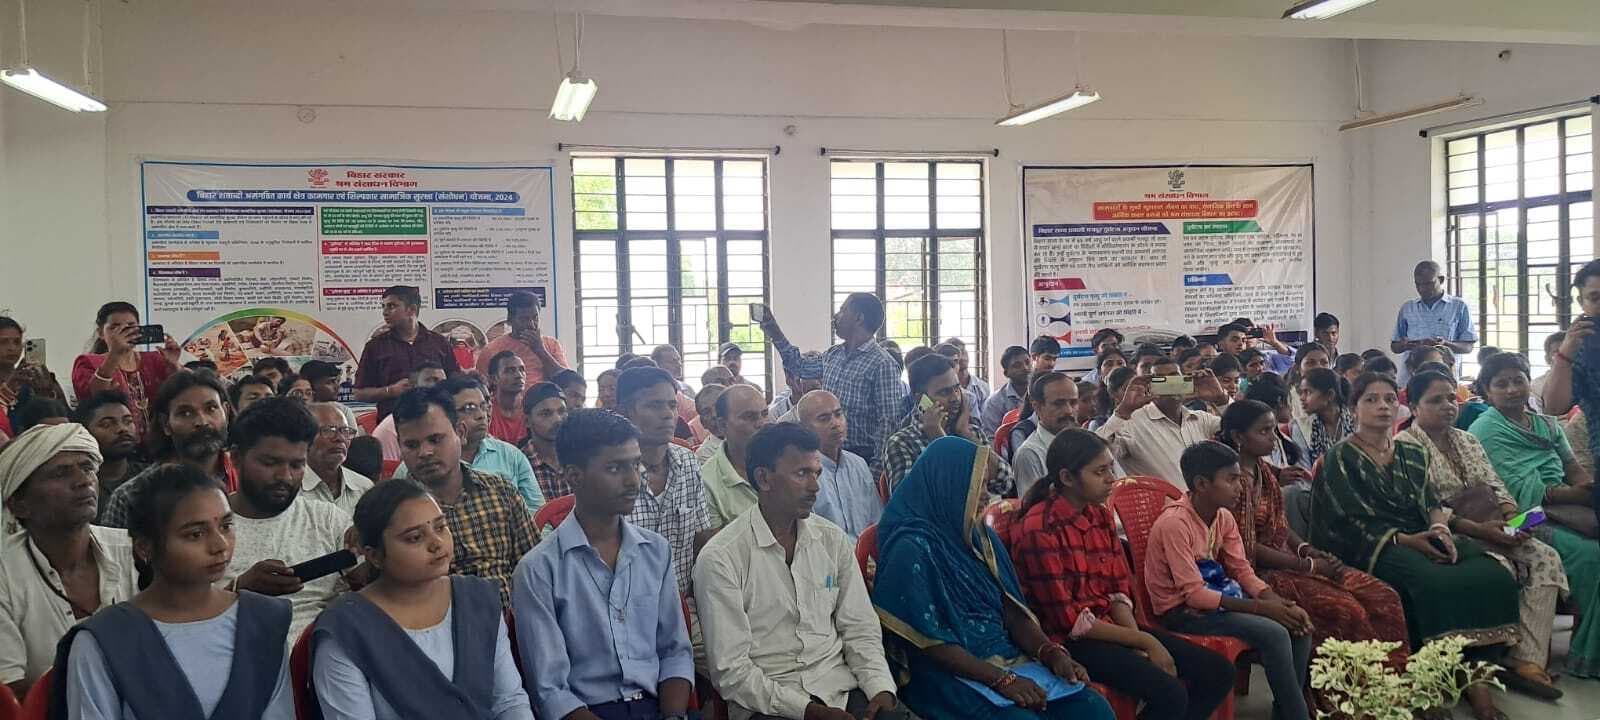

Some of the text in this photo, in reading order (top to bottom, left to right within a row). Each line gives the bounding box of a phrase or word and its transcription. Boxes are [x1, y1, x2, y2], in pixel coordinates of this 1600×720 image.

[347, 171, 406, 179] बिहार सरकार
[197, 191, 216, 200] बिहार
[277, 192, 292, 200] कार्य
[293, 192, 306, 201] क्षेत्र
[1186, 190, 1208, 198] विभाग
